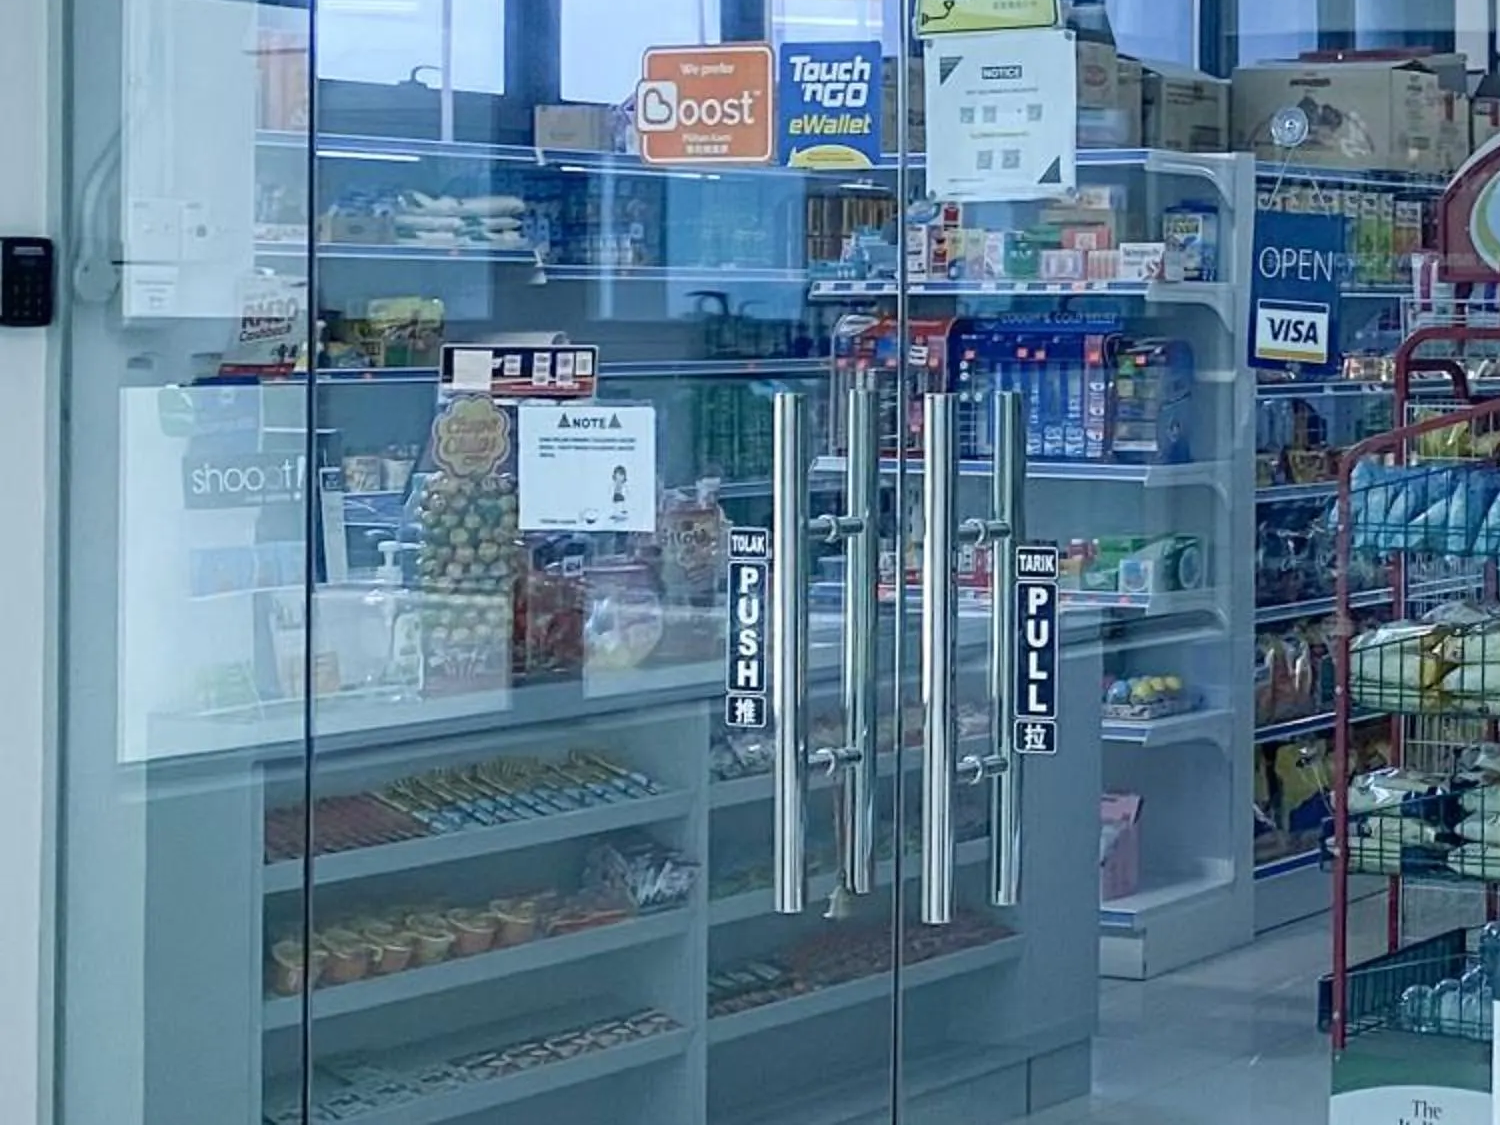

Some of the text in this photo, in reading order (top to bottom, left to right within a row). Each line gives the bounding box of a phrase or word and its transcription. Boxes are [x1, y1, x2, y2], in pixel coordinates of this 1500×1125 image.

[789, 55, 871, 82] Touch
[983, 66, 1022, 79] NOTICE
[789, 115, 871, 135] eWallet
[1259, 246, 1334, 282] OPEN
[1265, 317, 1319, 345] VISA
[572, 418, 606, 429] NOTE
[731, 536, 766, 553] TOLAK
[1018, 553, 1055, 573] TARIK
[735, 566, 760, 688] PUSH
[1026, 587, 1049, 712] PULL
[734, 699, 757, 724] 推
[1023, 725, 1047, 751] 拉
[1411, 1099, 1443, 1119] The
